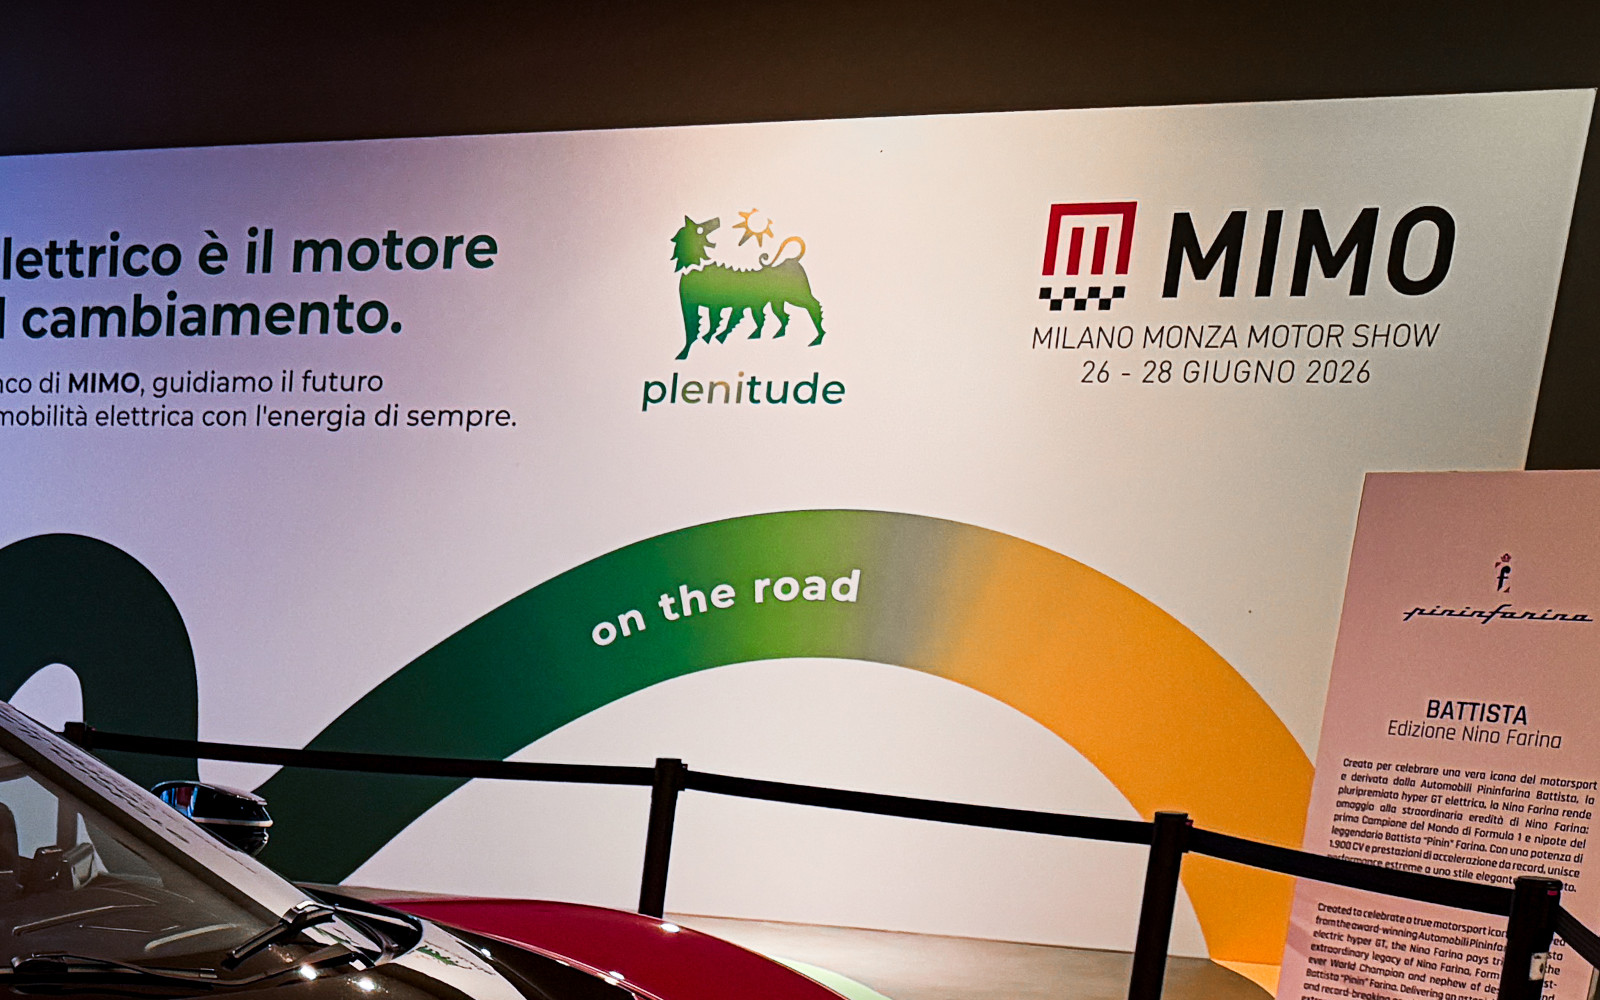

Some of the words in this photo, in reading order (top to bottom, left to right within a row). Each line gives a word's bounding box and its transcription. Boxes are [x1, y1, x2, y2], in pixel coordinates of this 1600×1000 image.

[199, 230, 228, 274] è
[247, 227, 273, 273] il
[293, 230, 497, 272] motore
[1162, 206, 1455, 297] MIMO
[23, 291, 401, 338] cambiamento.
[1033, 326, 1133, 348] MILANO
[1143, 326, 1237, 348] MONZA
[1248, 325, 1344, 348] MOTOR
[1353, 324, 1440, 347] SHOW
[40, 372, 59, 393] di
[69, 373, 144, 396] MIMO,
[153, 371, 272, 398] guidiamo
[282, 370, 293, 392] il
[302, 370, 382, 392] futuro
[1081, 361, 1109, 383] 26
[1143, 361, 1171, 383] 28
[1184, 360, 1294, 383] GIUGNO
[1306, 360, 1369, 383] 2026
[642, 372, 845, 411] plenitude
[96, 405, 193, 426] elettrica
[203, 411, 246, 426] con
[257, 404, 365, 431] l'energia
[375, 404, 398, 426] di
[407, 410, 515, 431] sempre.
[592, 610, 645, 645] on
[659, 584, 735, 620] the
[755, 570, 860, 602] road
[1403, 604, 1594, 625] pininfarina
[1426, 699, 1528, 726] BATTISTA
[1387, 719, 1456, 741] Edizione
[1462, 725, 1500, 744] Nino
[1506, 729, 1562, 749] Farina
[1343, 759, 1373, 769] Creata
[1377, 763, 1392, 771] per
[1395, 763, 1439, 775] celebrare
[1442, 769, 1461, 777] una
[1465, 771, 1486, 779] vera
[1490, 771, 1516, 782] icona
[1520, 774, 1536, 784] del
[1540, 778, 1597, 790] motorsport
[1351, 773, 1388, 784] derivata
[1393, 777, 1416, 787] dalla
[1421, 780, 1472, 792] Automobili
[1477, 785, 1530, 798] Pininfarina
[1536, 791, 1579, 804] Battista,
[1585, 795, 1595, 805] la
[1338, 786, 1399, 799] pluripremiata
[1402, 791, 1428, 802] hyper
[1431, 795, 1443, 803] GT
[1445, 796, 1486, 809] elettrica,
[1490, 800, 1499, 810] la
[1502, 802, 1524, 812] Nino
[1528, 805, 1559, 816] Farina
[1562, 810, 1592, 820] rende
[1380, 804, 1397, 813] alla
[1402, 807, 1463, 820] straordinaria
[1469, 814, 1504, 825] eredità
[1510, 817, 1519, 826] di
[1526, 819, 1548, 829] Nino
[1554, 822, 1589, 834] Farina:
[1332, 826, 1383, 840] leggendario
[1386, 832, 1421, 844] Battista
[1456, 840, 1487, 852] Farina.
[1490, 844, 1508, 854] Con
[1510, 848, 1528, 857] una
[1530, 851, 1571, 862] potenza
[1574, 854, 1583, 863] di
[1362, 816, 1407, 828] Campione
[1410, 821, 1425, 830] del
[1428, 823, 1459, 834] Mondo
[1462, 827, 1471, 835] di
[1474, 828, 1514, 840] Formula
[1518, 833, 1521, 841] 1
[1534, 835, 1567, 847] nipote
[1570, 839, 1586, 848] del
[1352, 842, 1365, 851] CV
[1371, 846, 1422, 858] prestazioni
[1423, 851, 1432, 859] di
[1433, 854, 1498, 868] accelerazione
[1499, 860, 1511, 869] da
[1513, 863, 1546, 874] record,
[1548, 867, 1580, 878] unisce
[1385, 862, 1423, 873] estreme
[1433, 868, 1450, 876] uno
[1454, 869, 1473, 879] stile
[1318, 903, 1352, 915] Created
[1353, 908, 1362, 916] to
[1363, 910, 1405, 923] celebrate
[1414, 917, 1432, 927] true
[1434, 921, 1487, 935] motorsport
